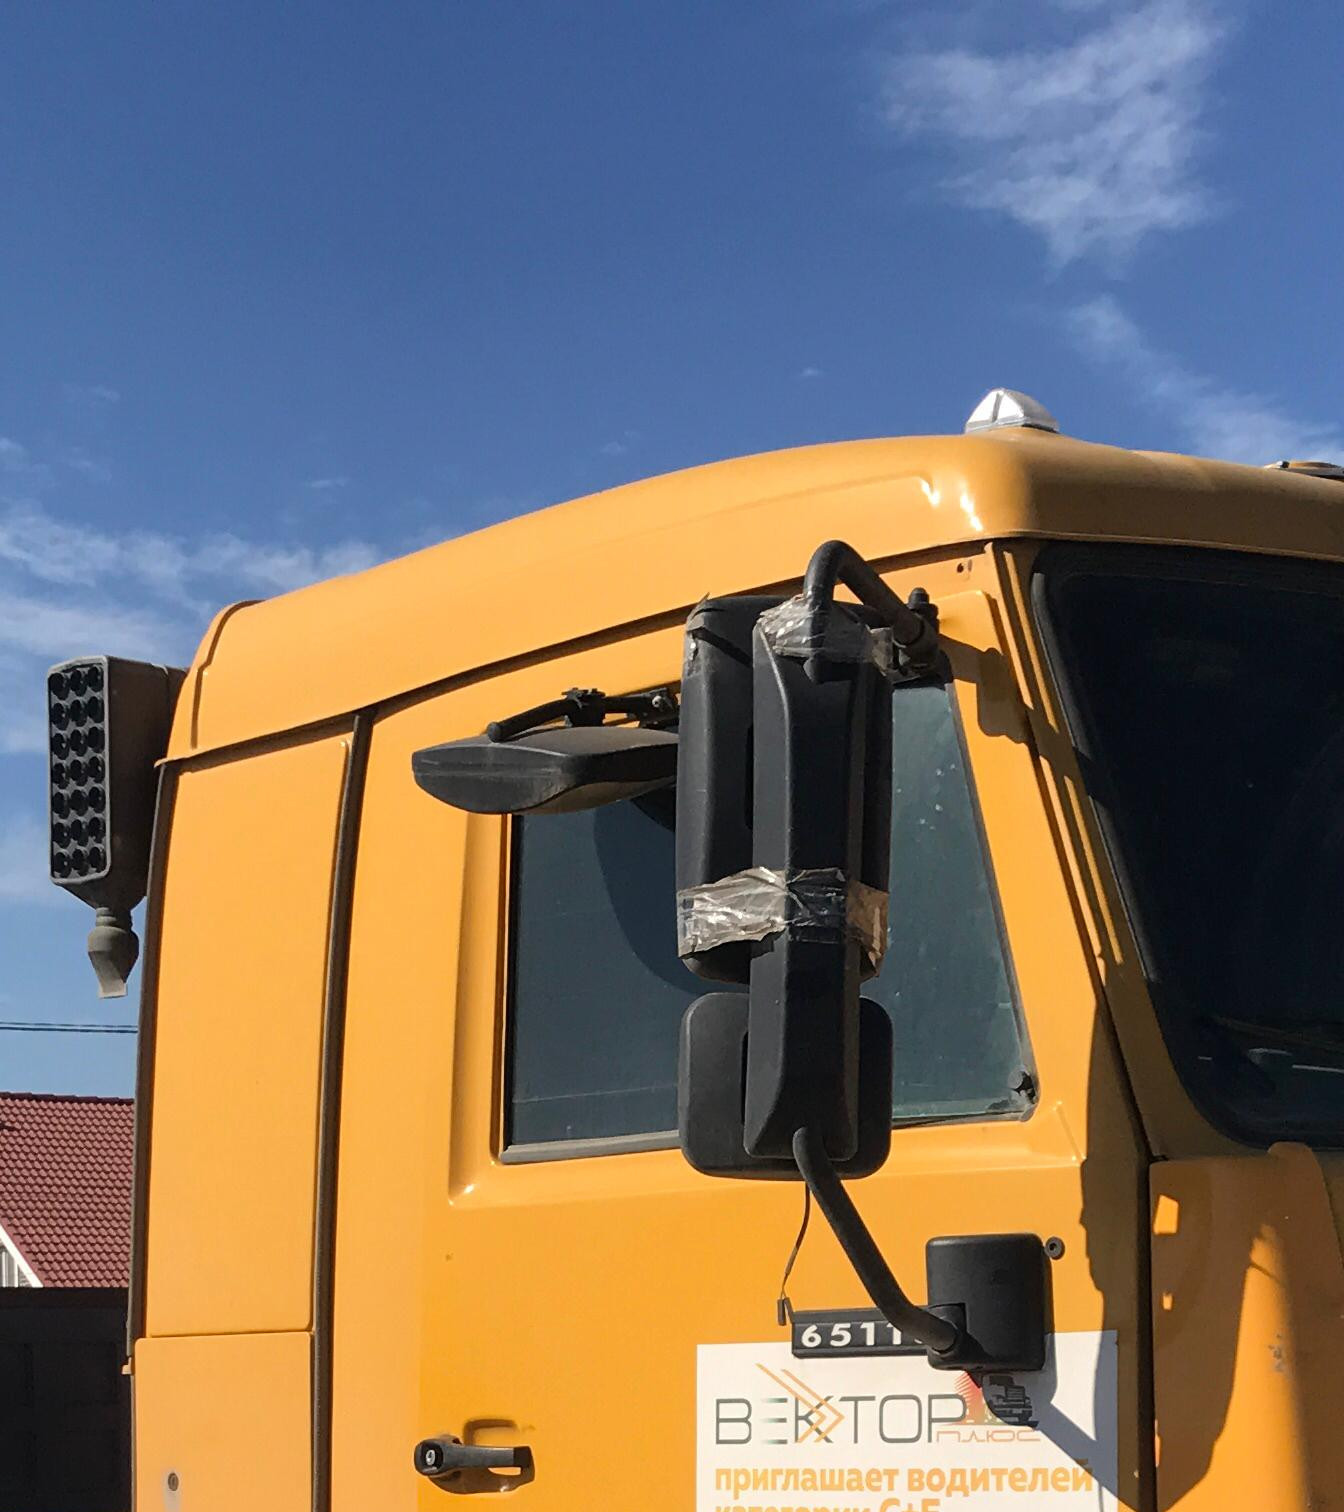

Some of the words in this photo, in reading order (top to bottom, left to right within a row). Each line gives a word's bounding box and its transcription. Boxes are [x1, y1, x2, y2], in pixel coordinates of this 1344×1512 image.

[801, 1322, 923, 1348] 6511
[715, 1467, 900, 1500] приглашает
[907, 1459, 1094, 1497] водителей
